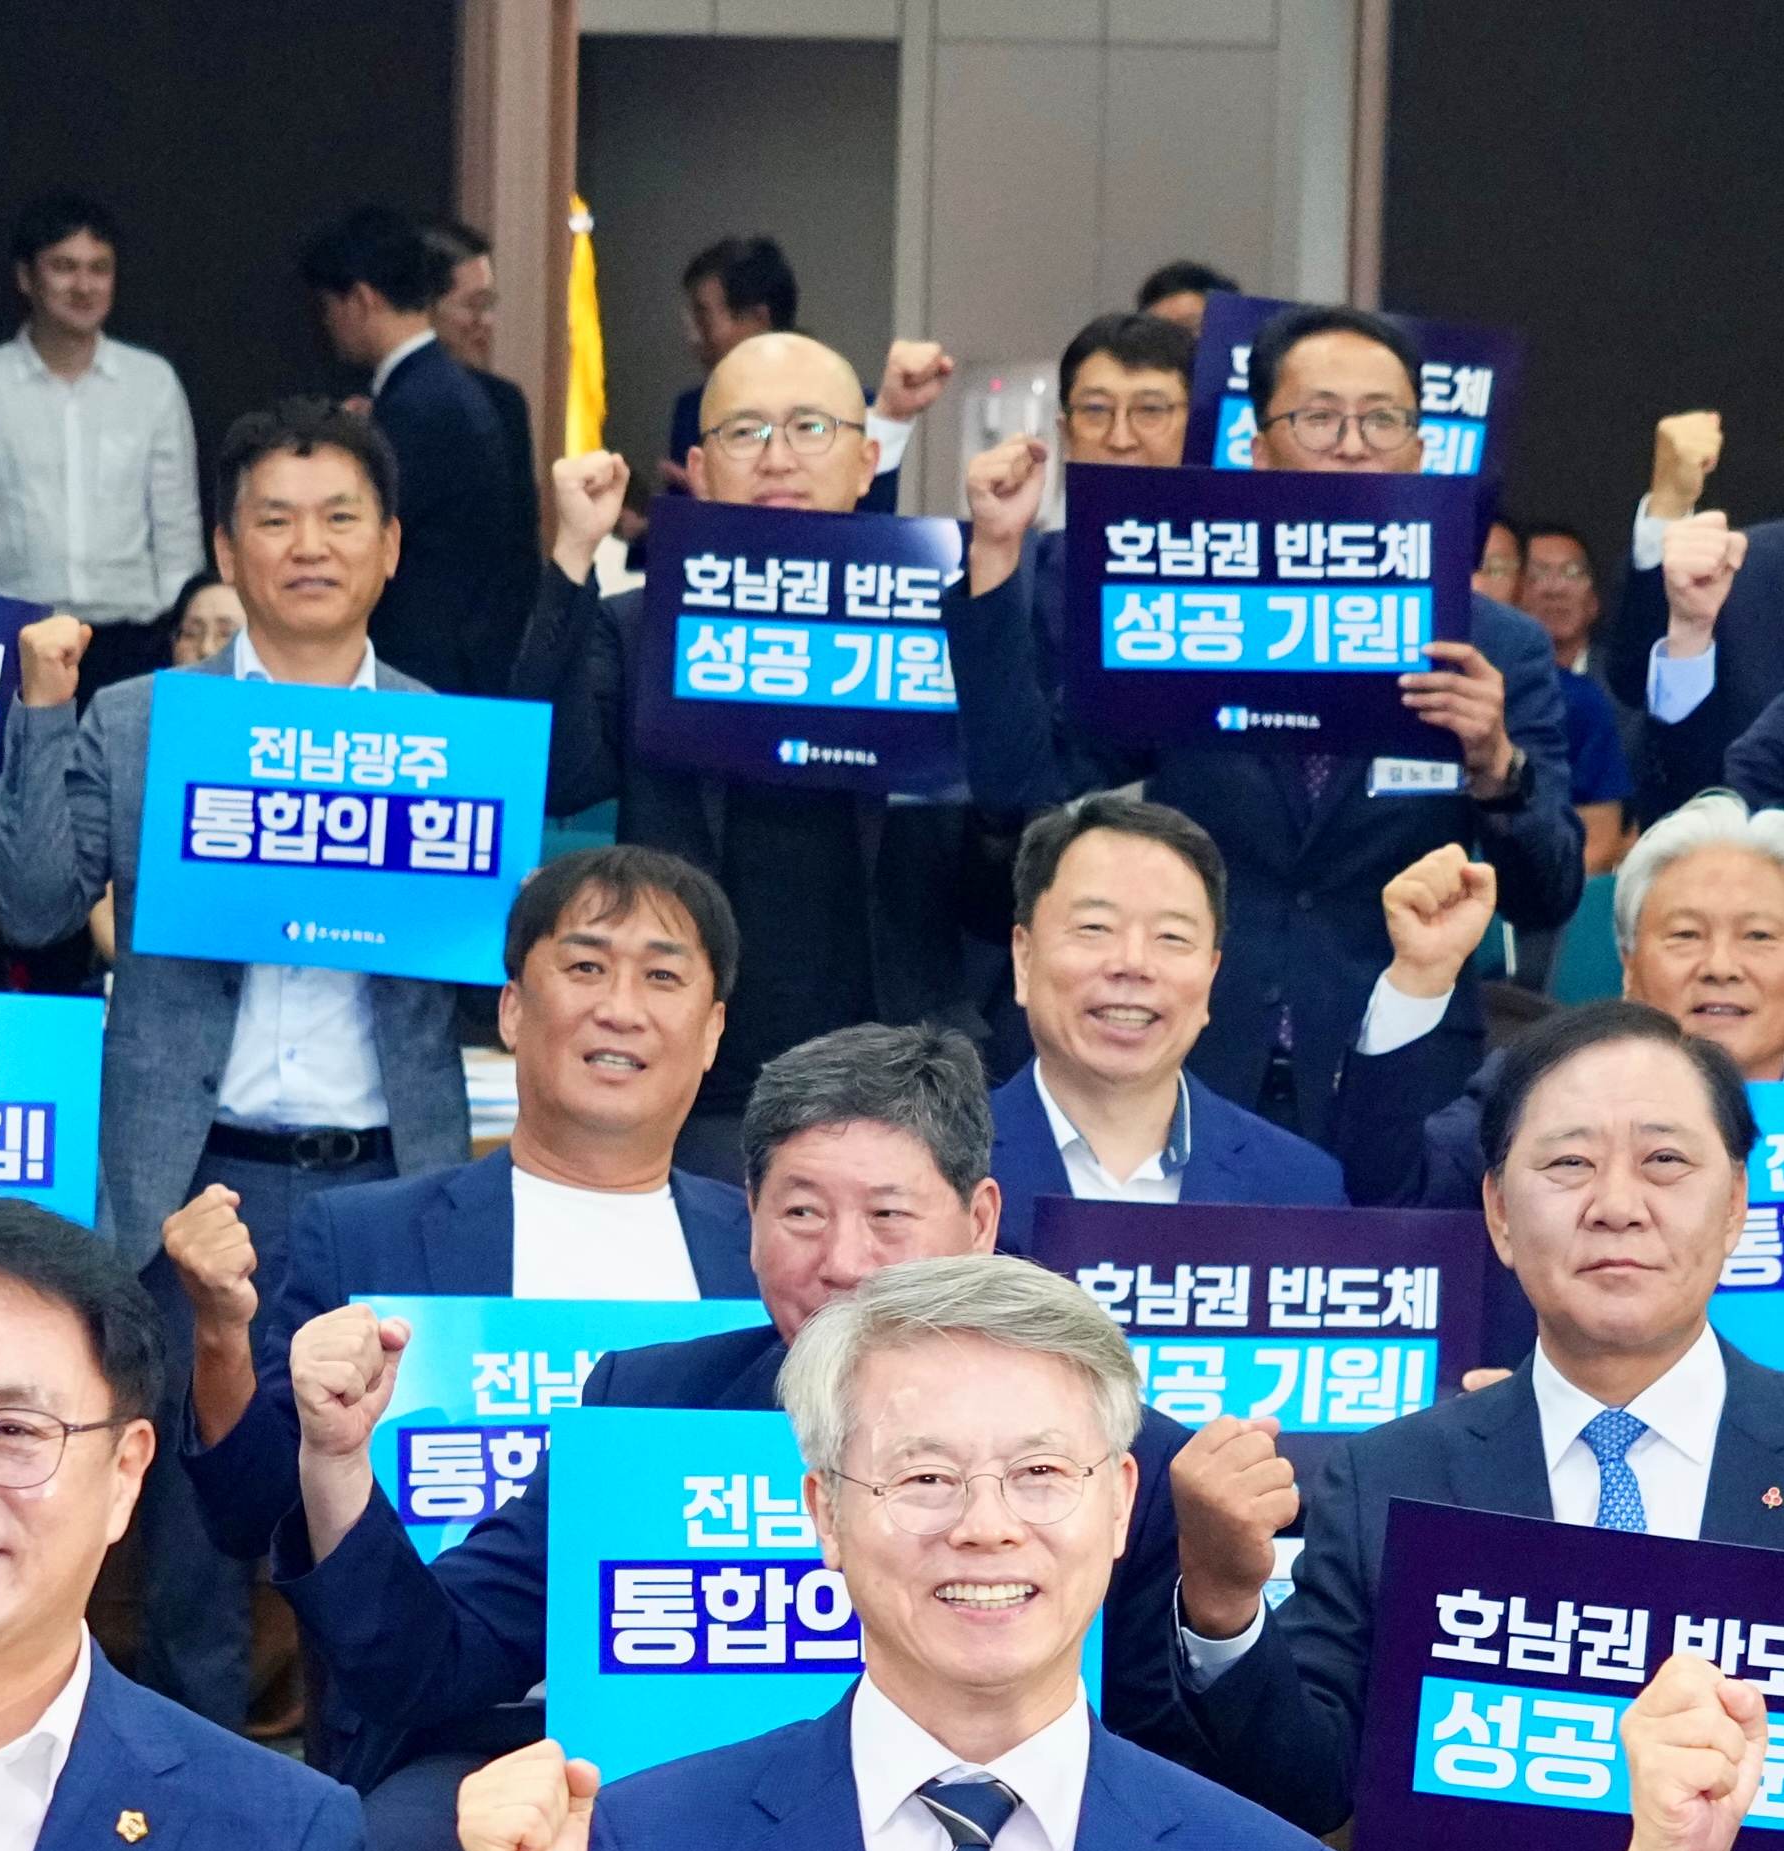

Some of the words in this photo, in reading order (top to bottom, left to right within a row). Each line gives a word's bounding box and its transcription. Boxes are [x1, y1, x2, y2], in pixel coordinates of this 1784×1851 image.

[1420, 362, 1494, 418] 도체
[1105, 519, 1260, 577] 호남권
[1274, 523, 1431, 579] 반도체
[682, 554, 830, 616] 호남권
[843, 561, 943, 621] 반도
[1114, 593, 1244, 661] 성공
[1267, 594, 1420, 663] 기원!
[686, 624, 812, 697] 성공
[830, 631, 957, 704] 기원
[248, 726, 448, 789] 전남광주
[190, 787, 388, 867] 통합의
[408, 795, 495, 871] 힘!
[1077, 1262, 1251, 1329] 호남권
[1268, 1266, 1439, 1330] 반도체
[1248, 1346, 1426, 1425] 기원!
[1431, 1589, 1649, 1683] 호남권
[1433, 1691, 1616, 1797] 성공
